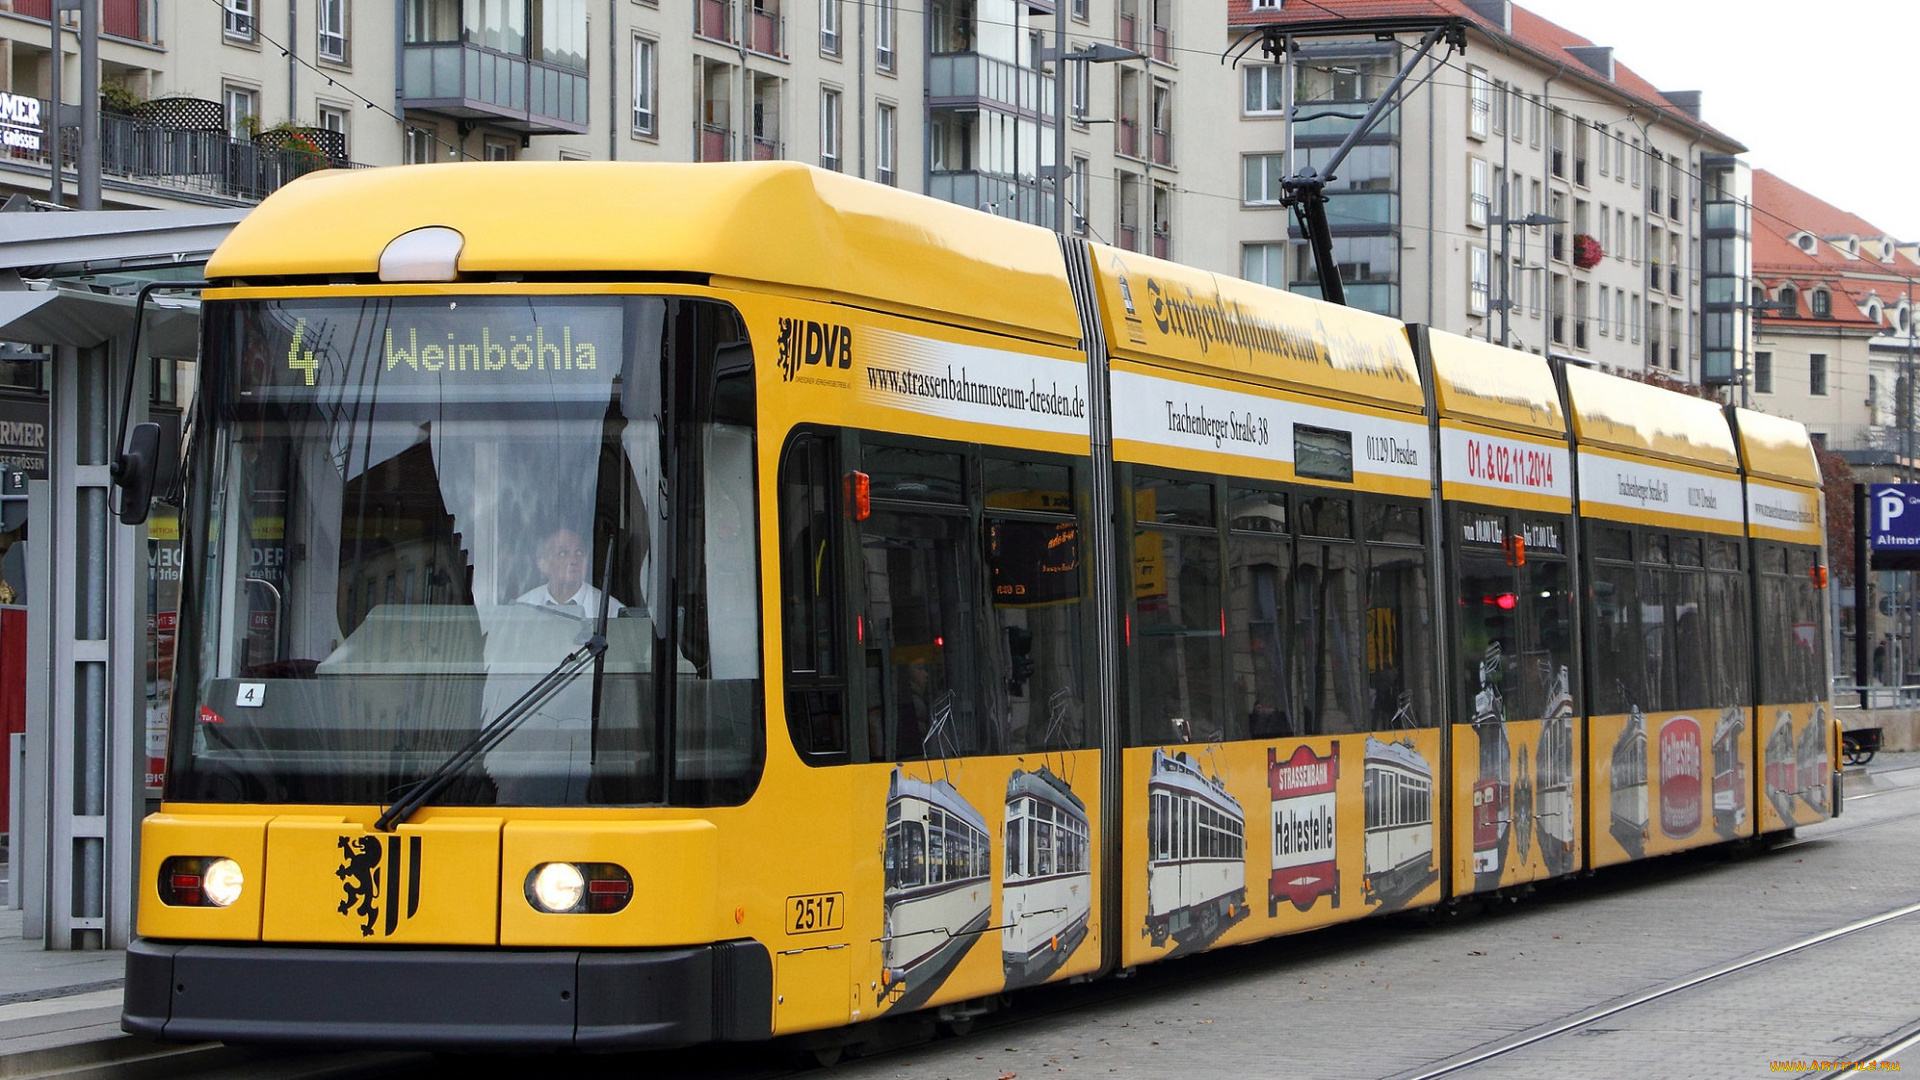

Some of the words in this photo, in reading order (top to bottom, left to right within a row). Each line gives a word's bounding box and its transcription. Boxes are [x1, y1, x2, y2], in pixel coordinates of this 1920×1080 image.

[0, 91, 40, 126] MER
[288, 317, 319, 386] 4
[386, 326, 597, 371] Weinböhla
[805, 320, 852, 370] DVB
[867, 364, 1085, 419] www.strassenbahnmuseum-dresden.de
[1165, 400, 1228, 449] Trachenberger
[1229, 410, 1256, 443] Straße
[1258, 417, 1269, 446] 38
[1366, 435, 1389, 463] 01129
[1390, 437, 1418, 466] Dresden
[1468, 439, 1485, 478] 01.
[1487, 443, 1495, 481] &
[1497, 445, 1553, 488] 02.11.2014
[1463, 524, 1475, 541] von
[1490, 520, 1503, 545] Uhr
[1523, 522, 1533, 546] bis
[1546, 524, 1558, 549] Uhr
[244, 688, 255, 702] 4
[1278, 763, 1328, 791] STRASSENBAHN
[1275, 805, 1333, 856] Haltestelle
[795, 896, 835, 930] 2517
